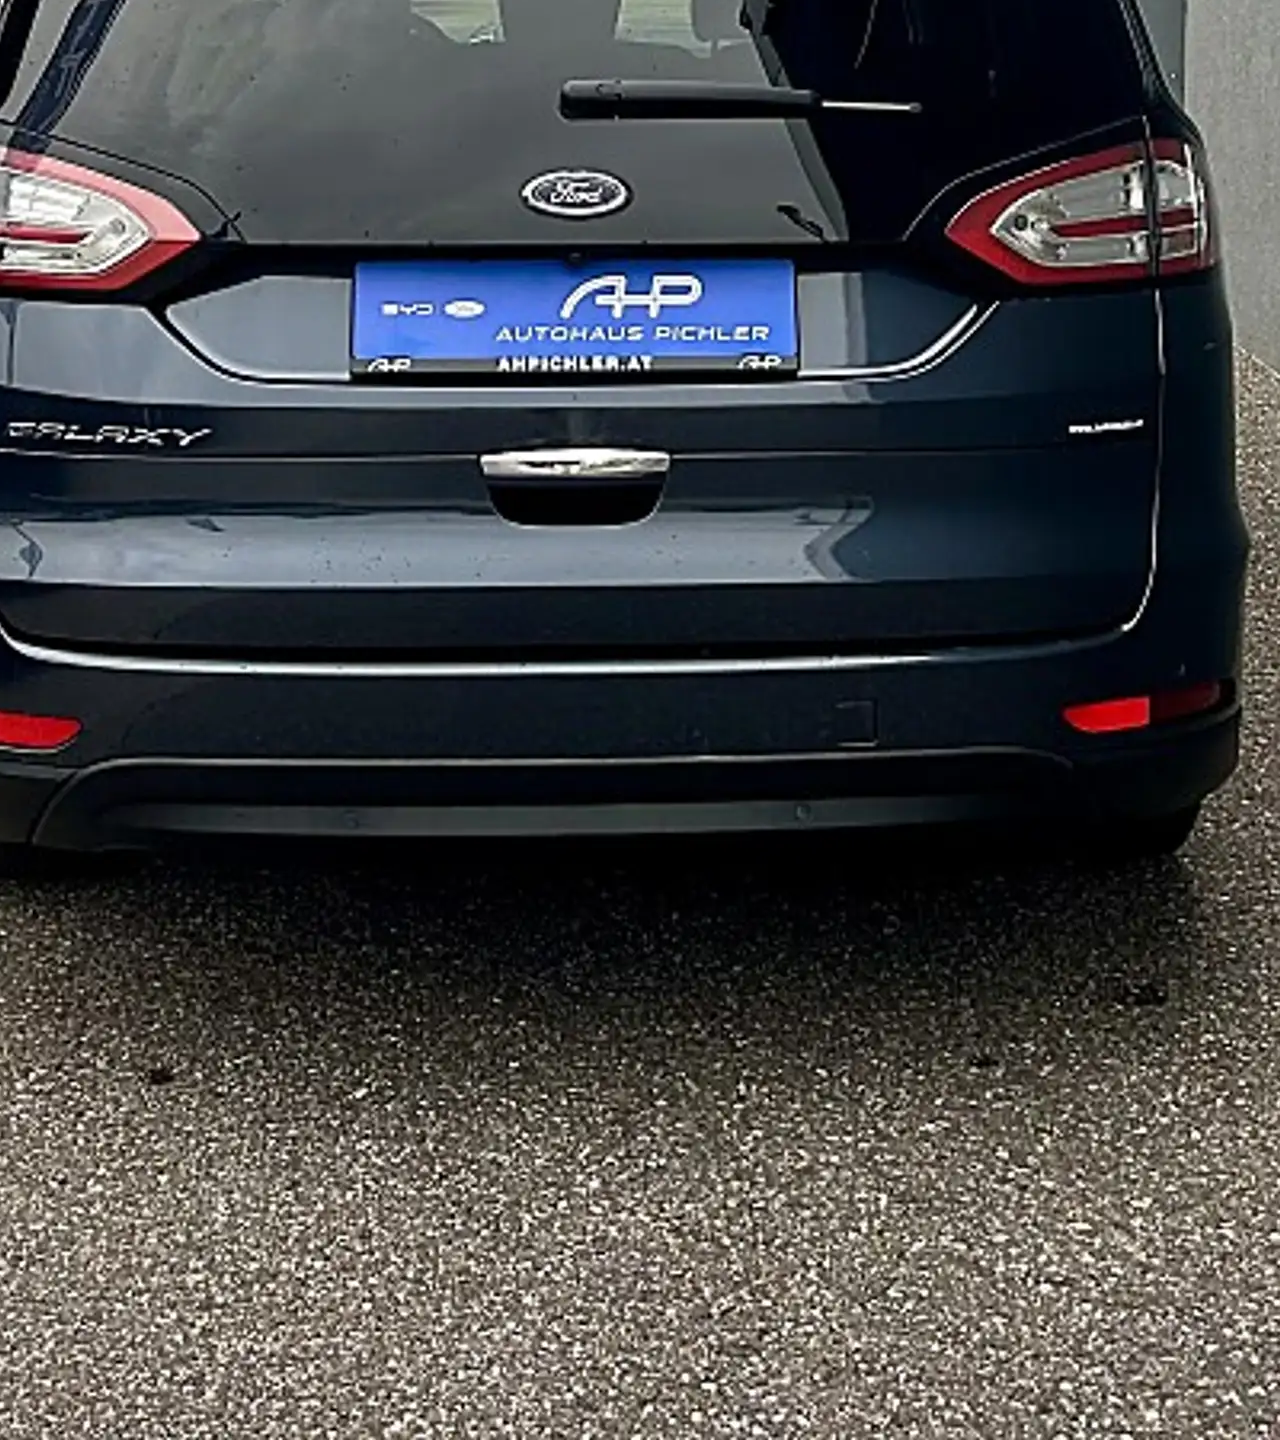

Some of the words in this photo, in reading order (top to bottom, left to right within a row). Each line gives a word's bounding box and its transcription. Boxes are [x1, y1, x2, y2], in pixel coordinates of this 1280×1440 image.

[495, 325, 645, 342] AUTOHAUS
[652, 325, 772, 342] PICHLER
[6, 420, 213, 447] GALAXY
